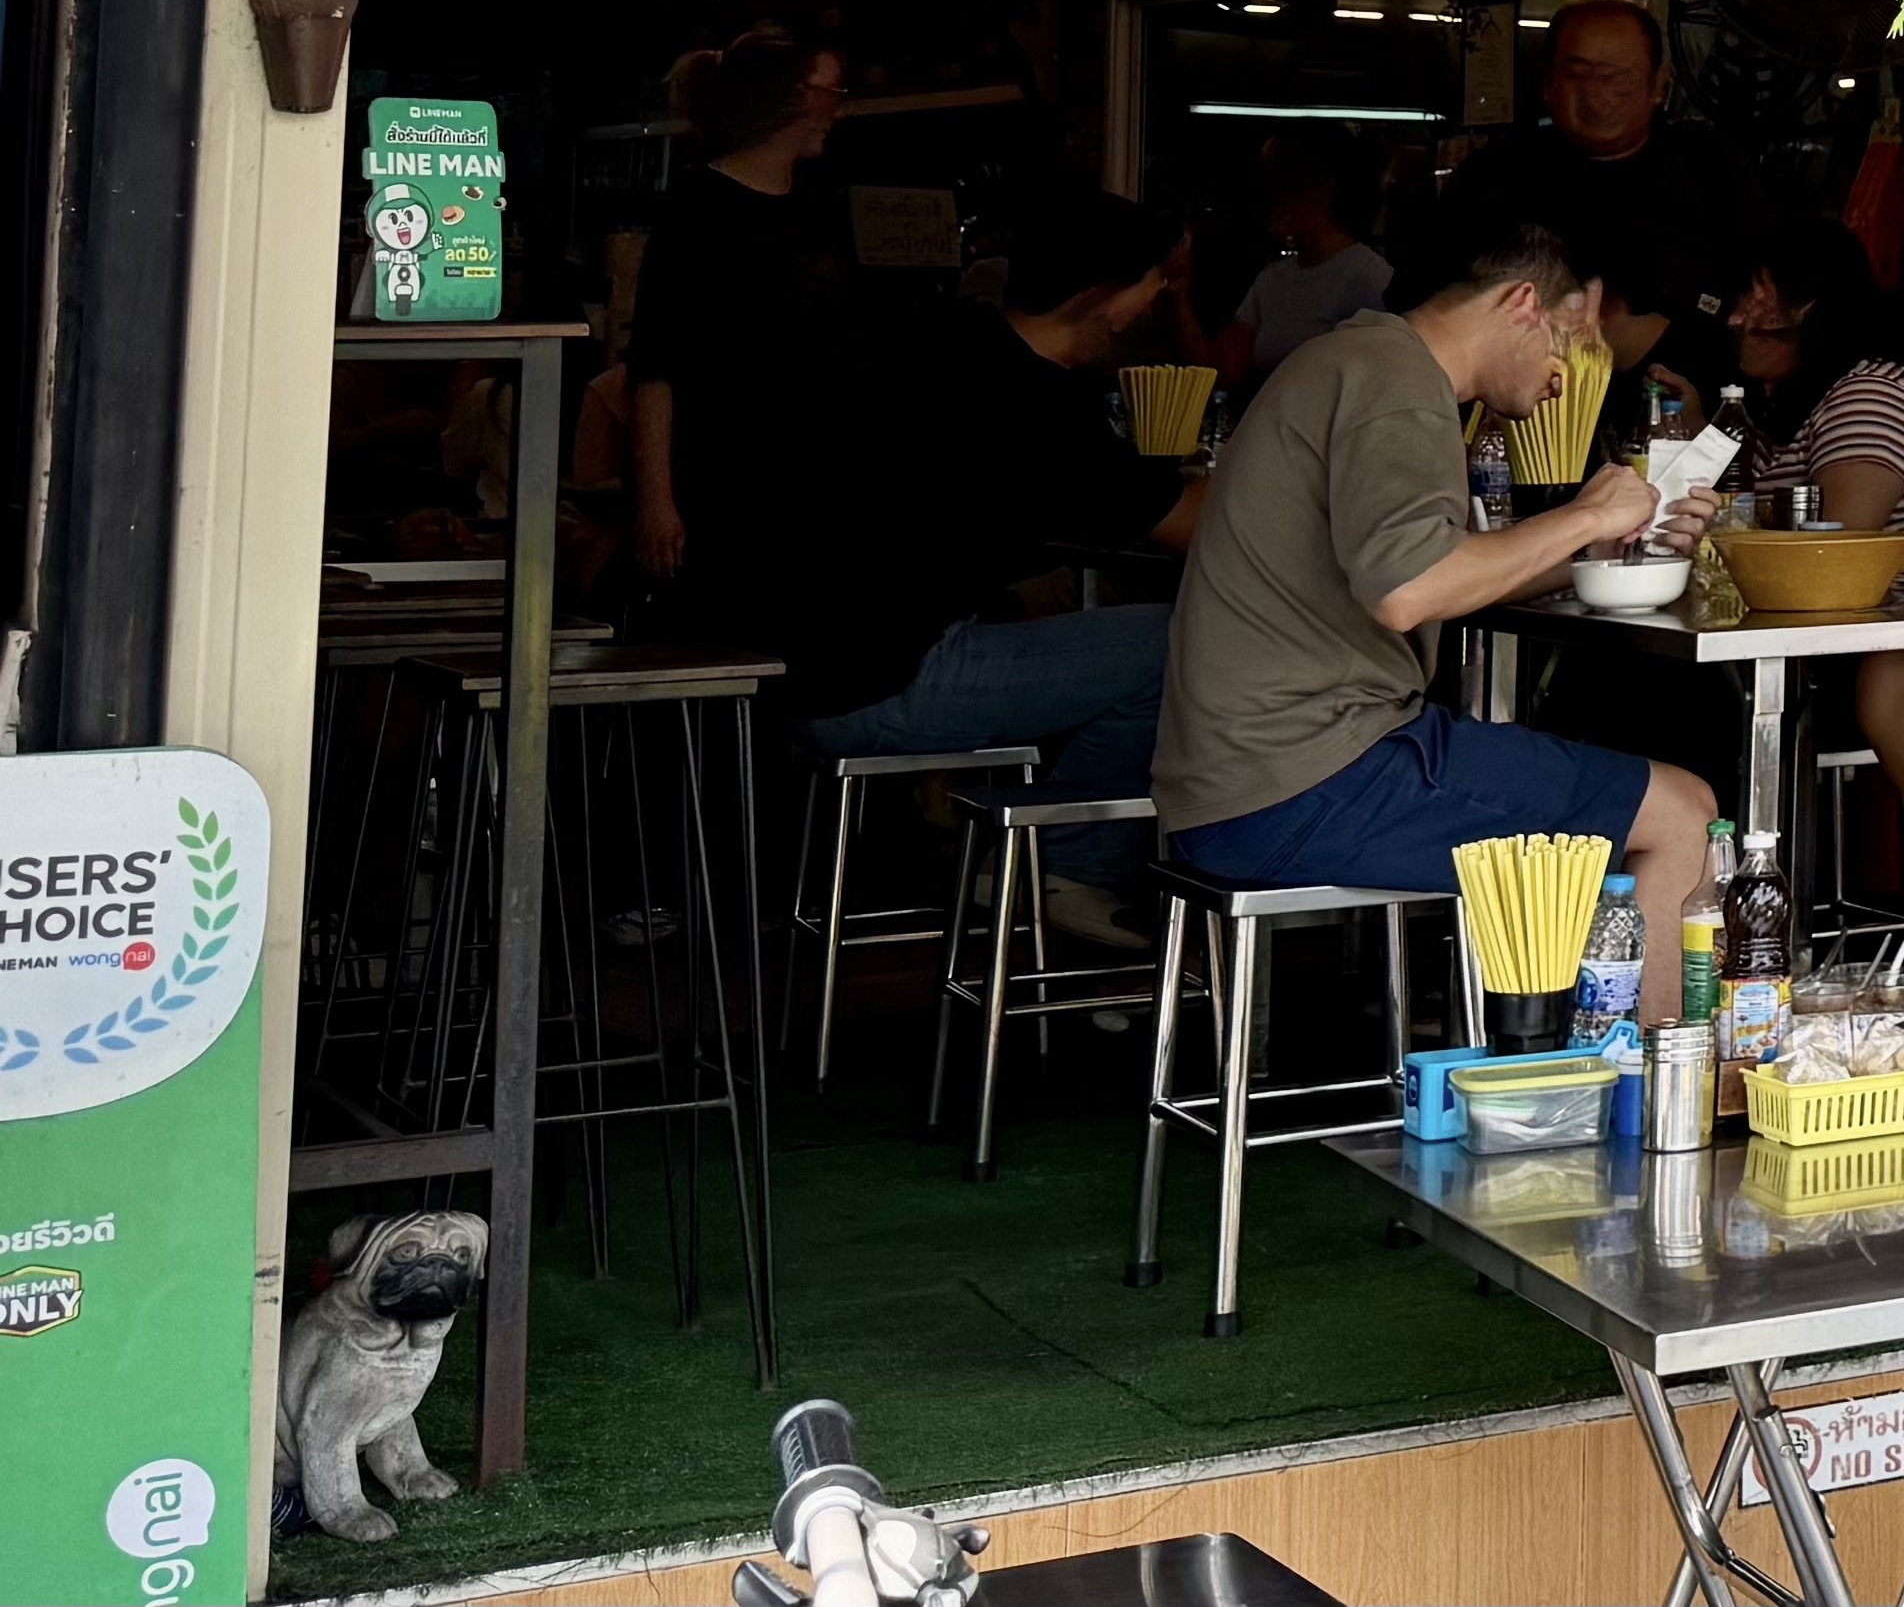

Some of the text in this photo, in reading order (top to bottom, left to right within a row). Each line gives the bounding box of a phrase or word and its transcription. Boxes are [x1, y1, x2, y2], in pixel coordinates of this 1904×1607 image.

[369, 151, 503, 178] LINE MAN
[0, 849, 172, 900] SERS'
[0, 901, 155, 943] HOICE
[0, 1277, 75, 1299] INE MAN
[1830, 1450, 1872, 1483] NO
